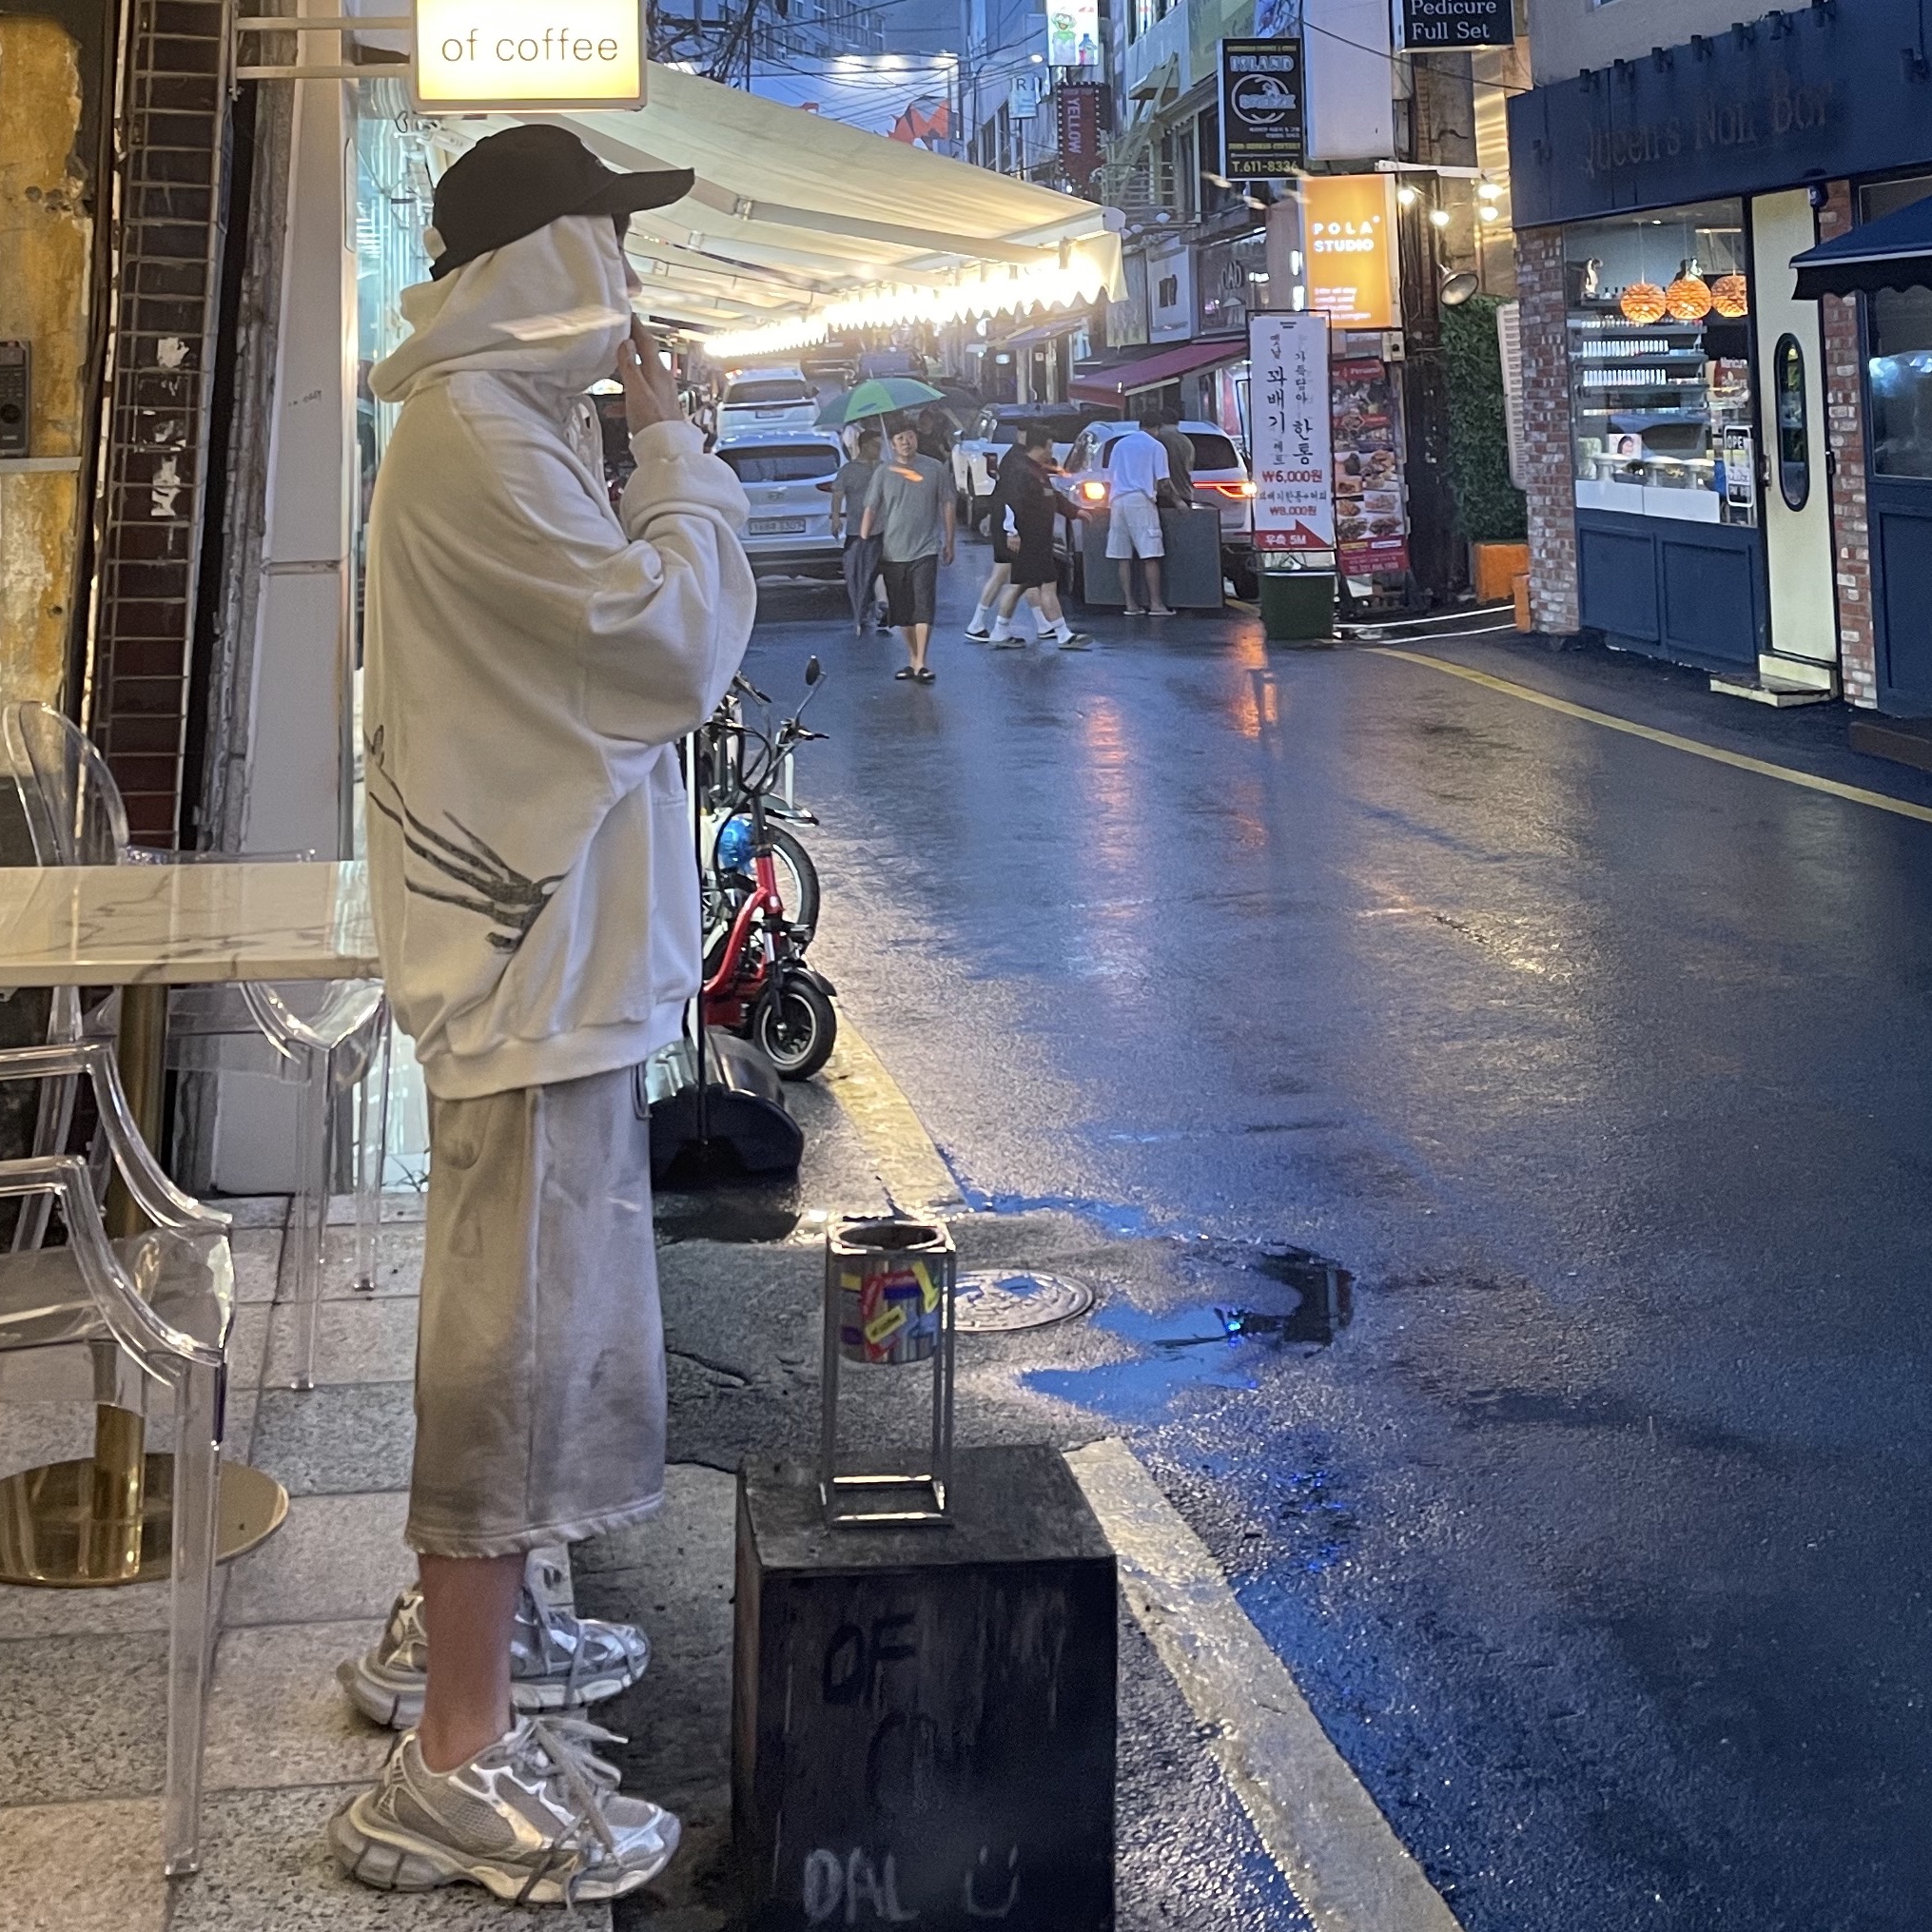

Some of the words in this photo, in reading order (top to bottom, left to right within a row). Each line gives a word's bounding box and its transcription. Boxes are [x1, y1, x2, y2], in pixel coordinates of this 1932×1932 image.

[1411, 0, 1497, 15] Pedicure
[1413, 22, 1449, 40] Full
[1456, 21, 1491, 39] Set
[441, 28, 479, 61] of
[496, 28, 618, 61] coffee
[1230, 55, 1295, 71] ISLAND
[1067, 97, 1083, 154] YELLOW
[1313, 221, 1374, 236] POLA
[1314, 238, 1375, 253] STUDIO
[1266, 365, 1288, 434] 꽈배기
[1292, 418, 1314, 465] 한통
[803, 1845, 921, 1927] DAL
